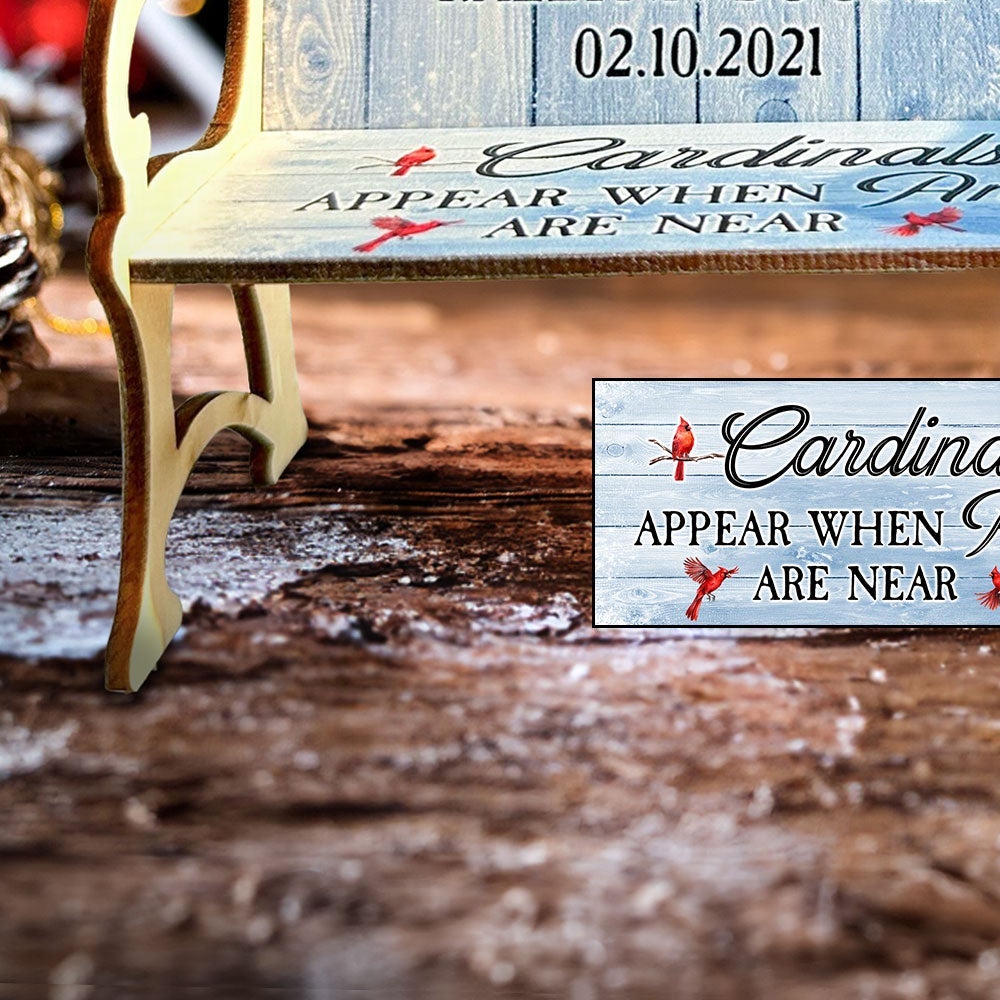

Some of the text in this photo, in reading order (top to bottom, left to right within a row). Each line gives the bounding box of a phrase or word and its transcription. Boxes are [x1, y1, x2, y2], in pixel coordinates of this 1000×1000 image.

[574, 27, 822, 78] 02.10.2021
[296, 187, 566, 211] APPEAR
[603, 183, 825, 205] WHEN
[484, 212, 842, 238] ARE NEAR
